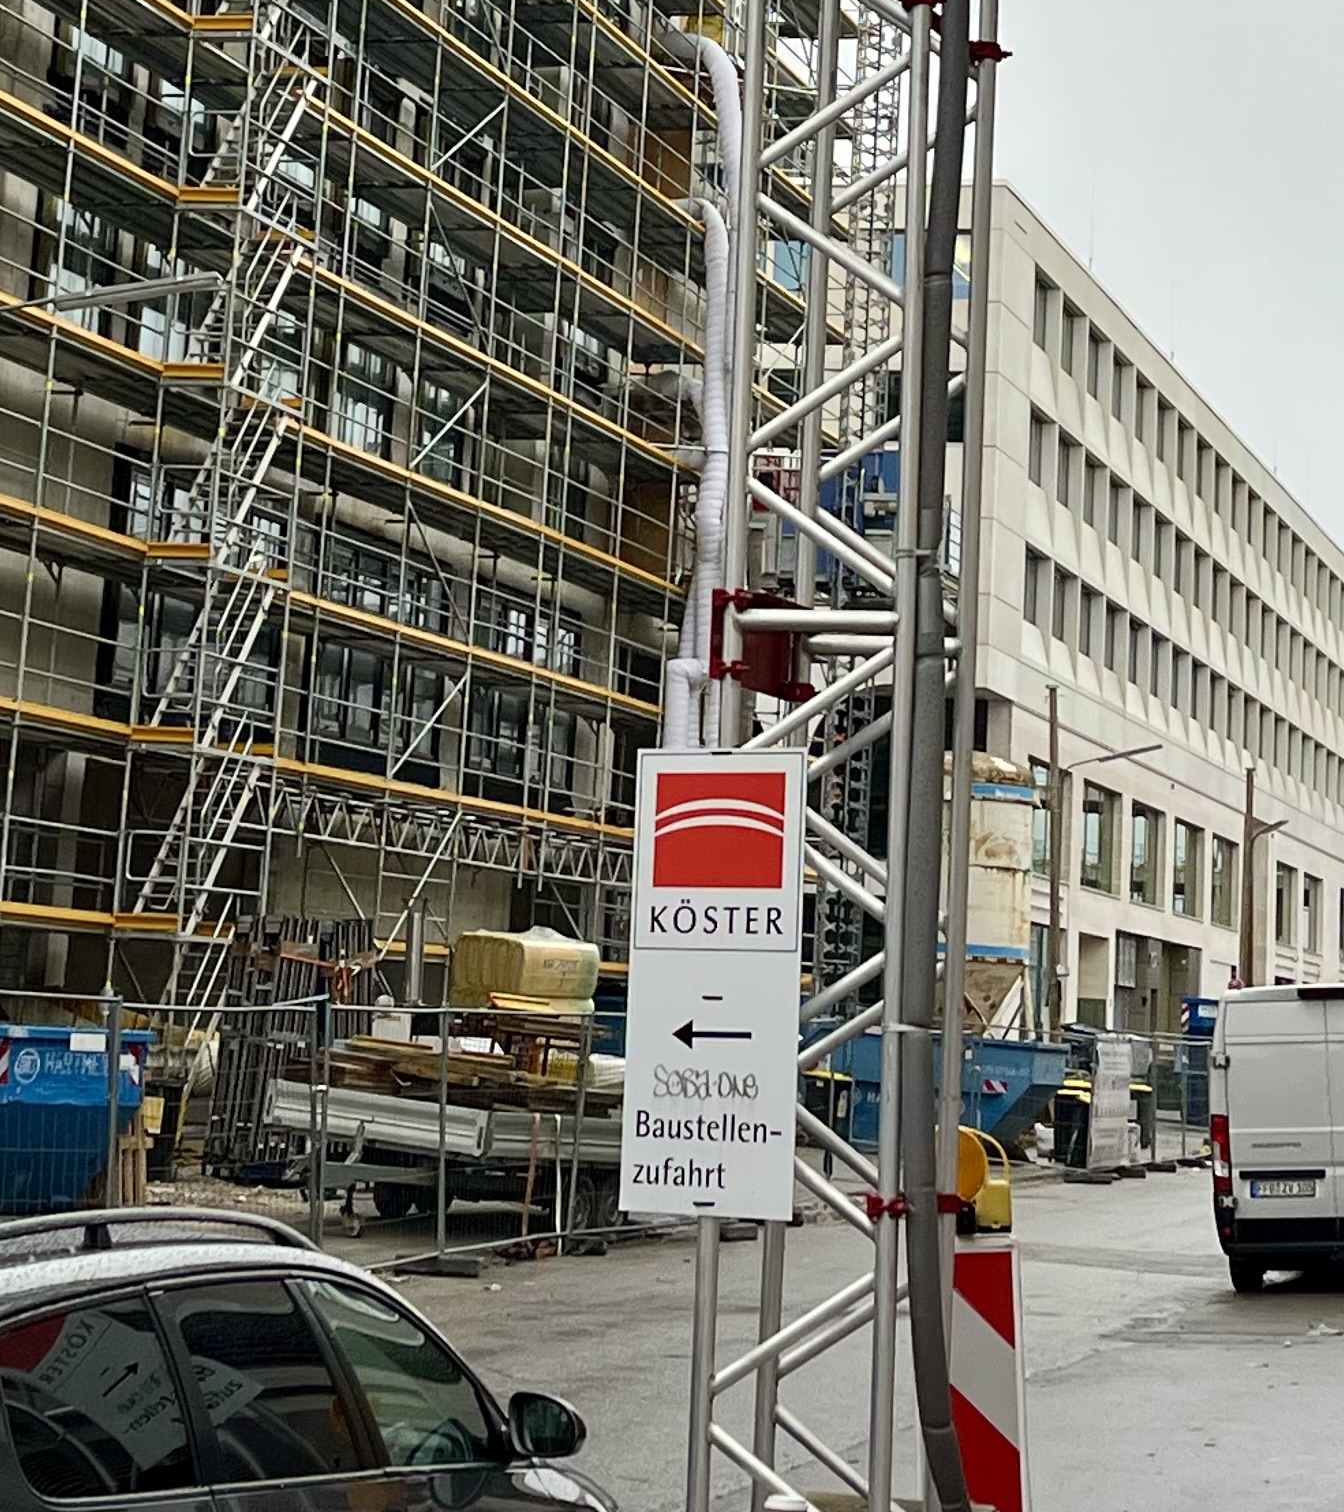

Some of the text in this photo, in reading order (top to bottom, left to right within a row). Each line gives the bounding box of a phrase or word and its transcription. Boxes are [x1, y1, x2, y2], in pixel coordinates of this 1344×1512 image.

[650, 899, 784, 935] KÖSTER
[635, 1109, 782, 1144] Baustellen-
[632, 1157, 726, 1189] zufahrt
